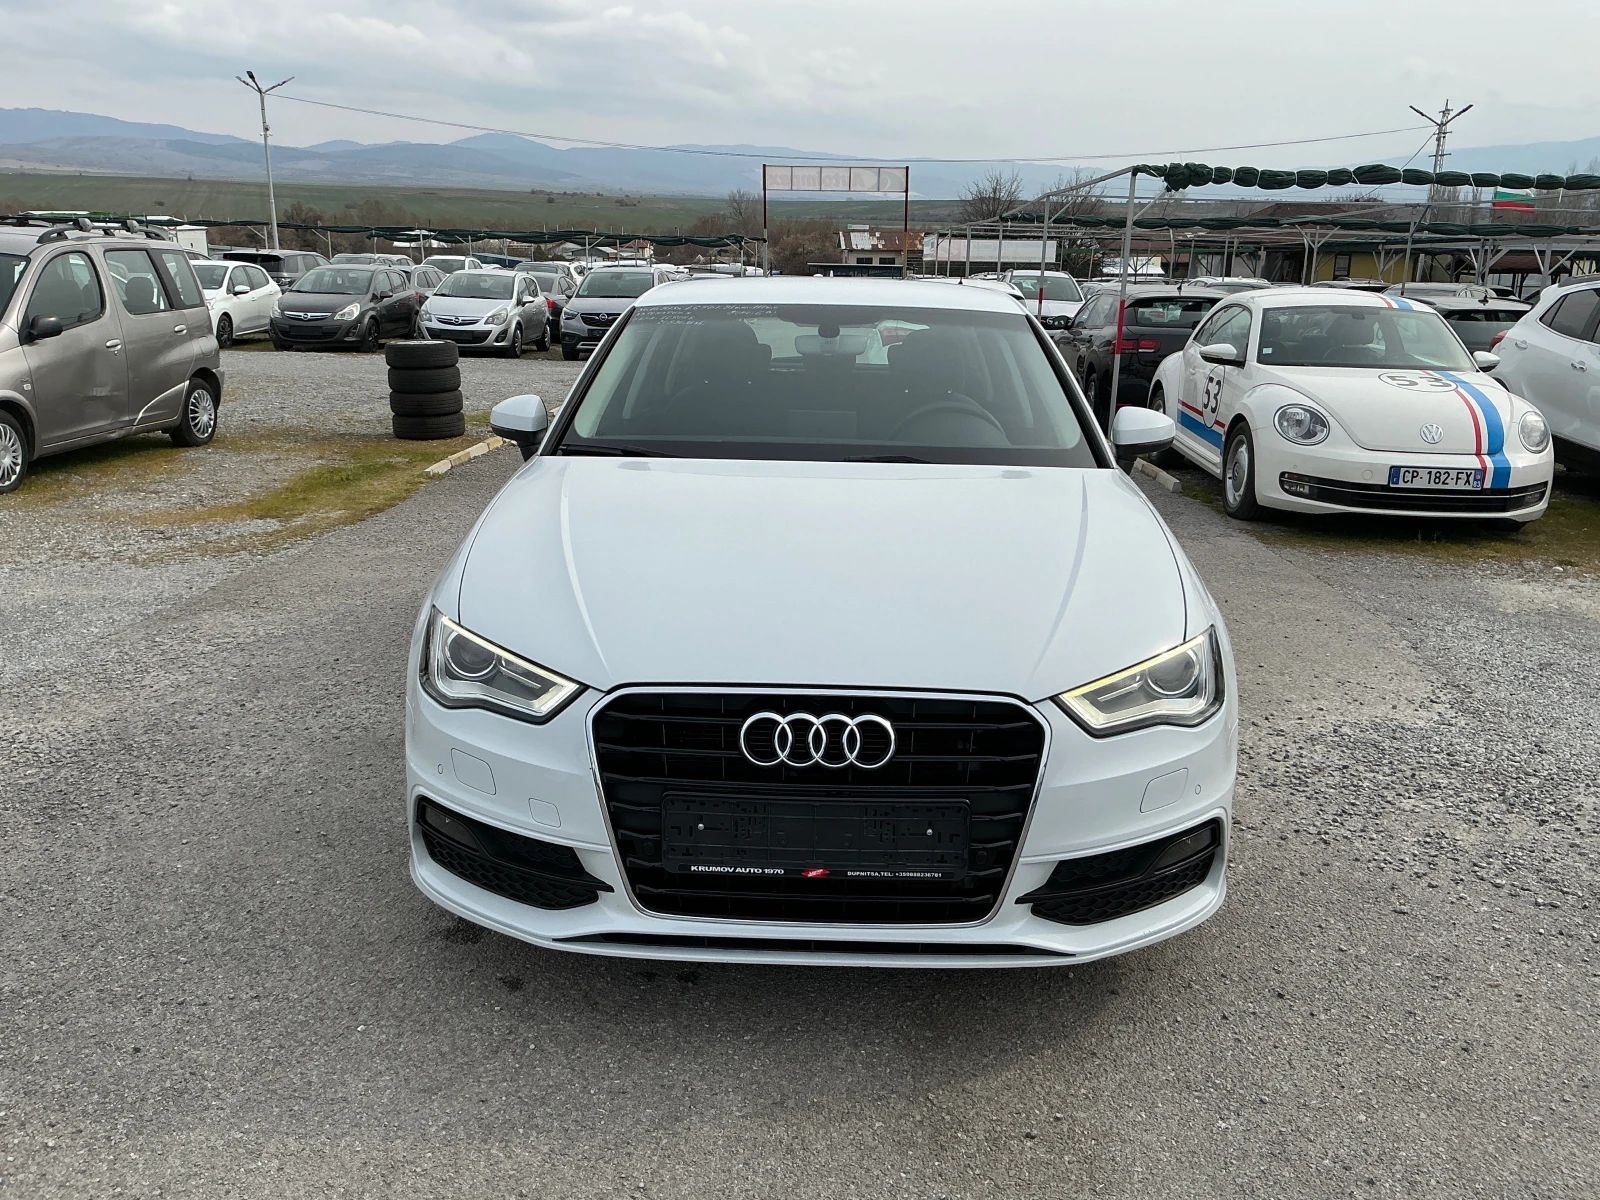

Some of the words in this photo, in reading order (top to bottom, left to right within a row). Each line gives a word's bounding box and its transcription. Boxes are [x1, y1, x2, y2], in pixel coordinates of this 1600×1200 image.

[1386, 375, 1453, 387] 53
[1203, 375, 1221, 413] 53
[1420, 423, 1444, 444] VW
[1402, 470, 1473, 486] CP-182-FX
